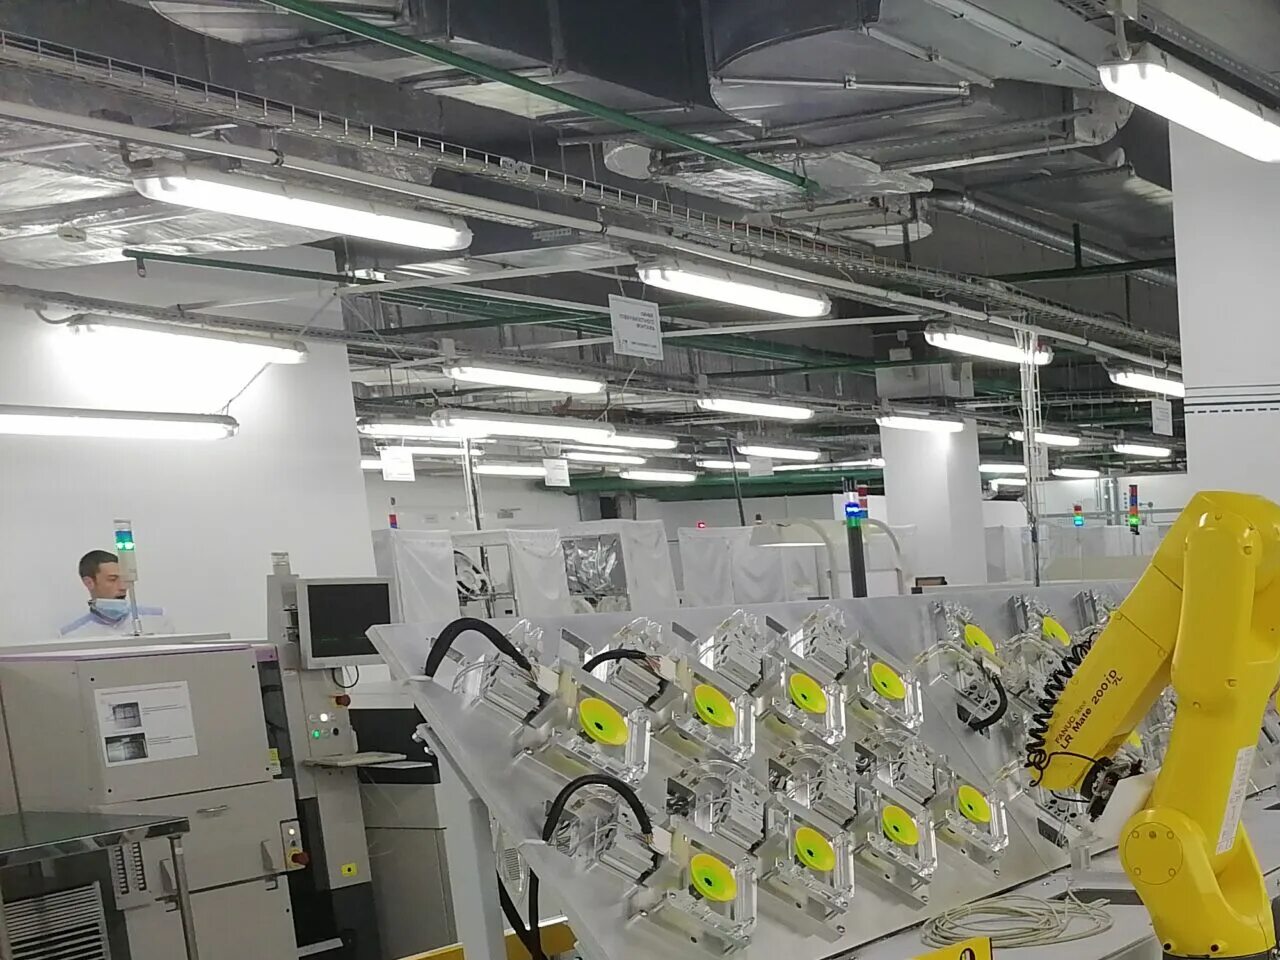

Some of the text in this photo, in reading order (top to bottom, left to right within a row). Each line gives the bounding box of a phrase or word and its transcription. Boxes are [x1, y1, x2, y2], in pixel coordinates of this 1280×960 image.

[1112, 676, 1124, 686] 7L
[1060, 734, 1074, 750] LR
[1072, 707, 1092, 732] Mate
[1091, 669, 1117, 705] 200iD
[1055, 715, 1076, 744] FANUC
